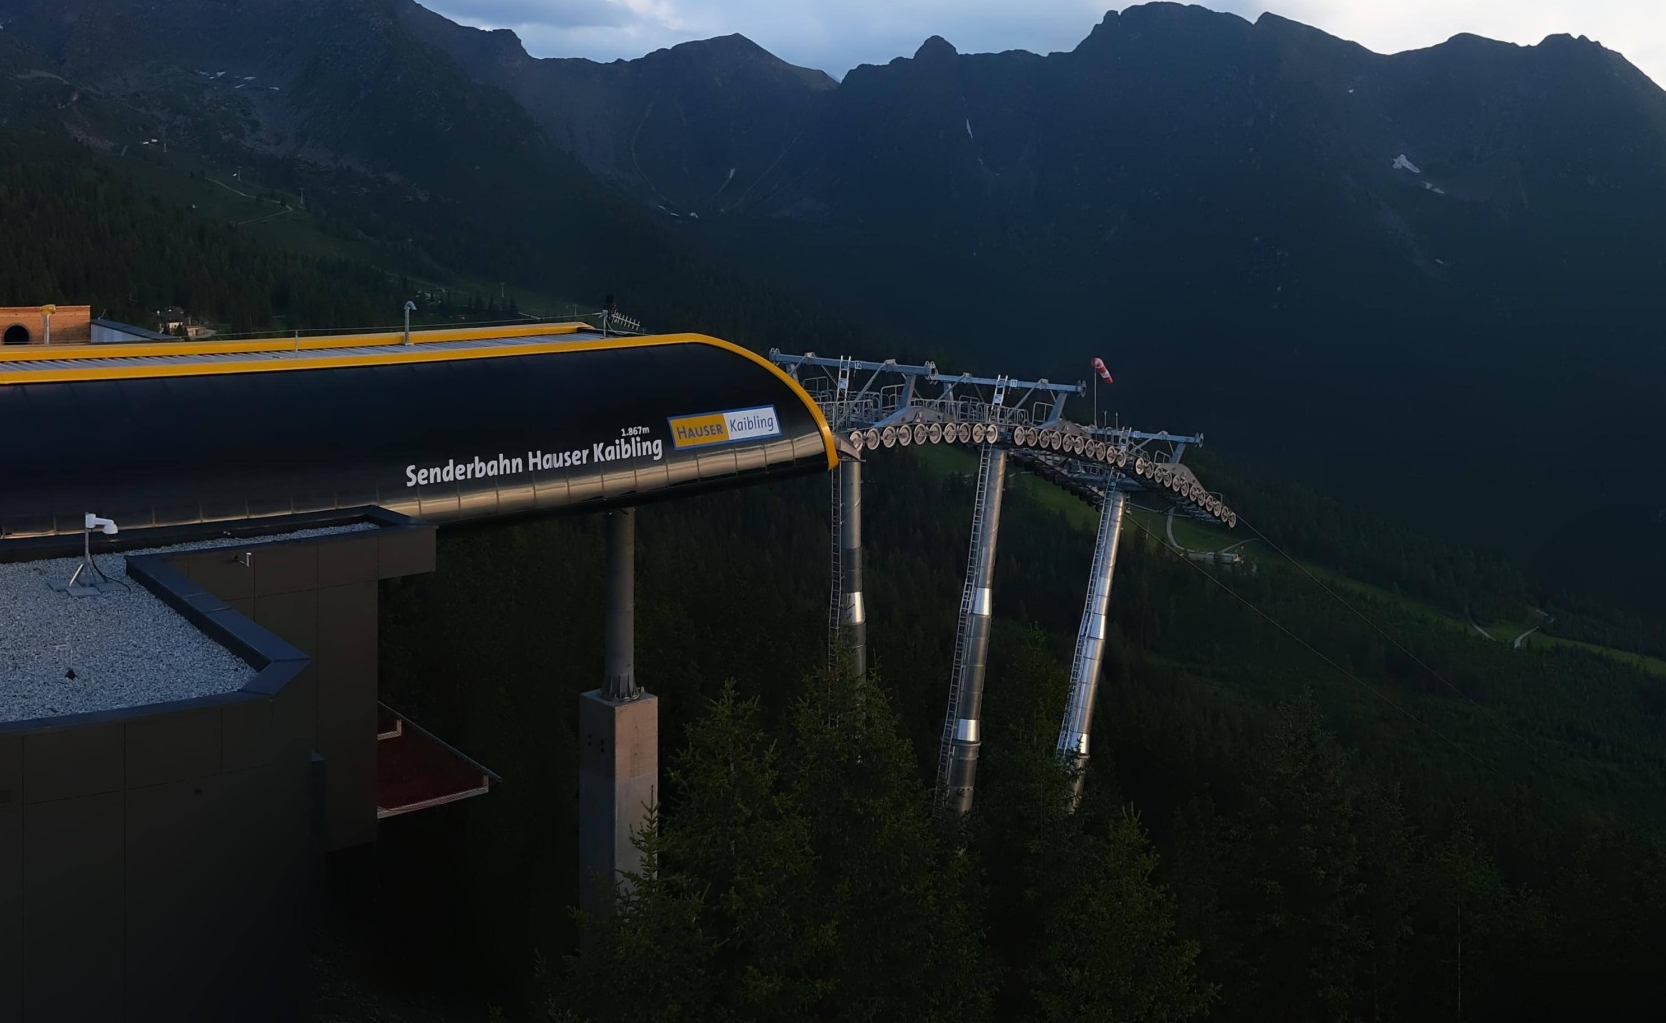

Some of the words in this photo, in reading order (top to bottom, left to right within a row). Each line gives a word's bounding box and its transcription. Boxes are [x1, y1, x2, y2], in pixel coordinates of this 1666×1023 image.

[621, 426, 650, 438] 1.867m
[676, 422, 724, 440] HAUSER
[729, 413, 775, 433] Kaibling
[405, 453, 523, 487] Senderbahn
[527, 447, 590, 472] Hauser
[593, 435, 663, 462] Kaibling
